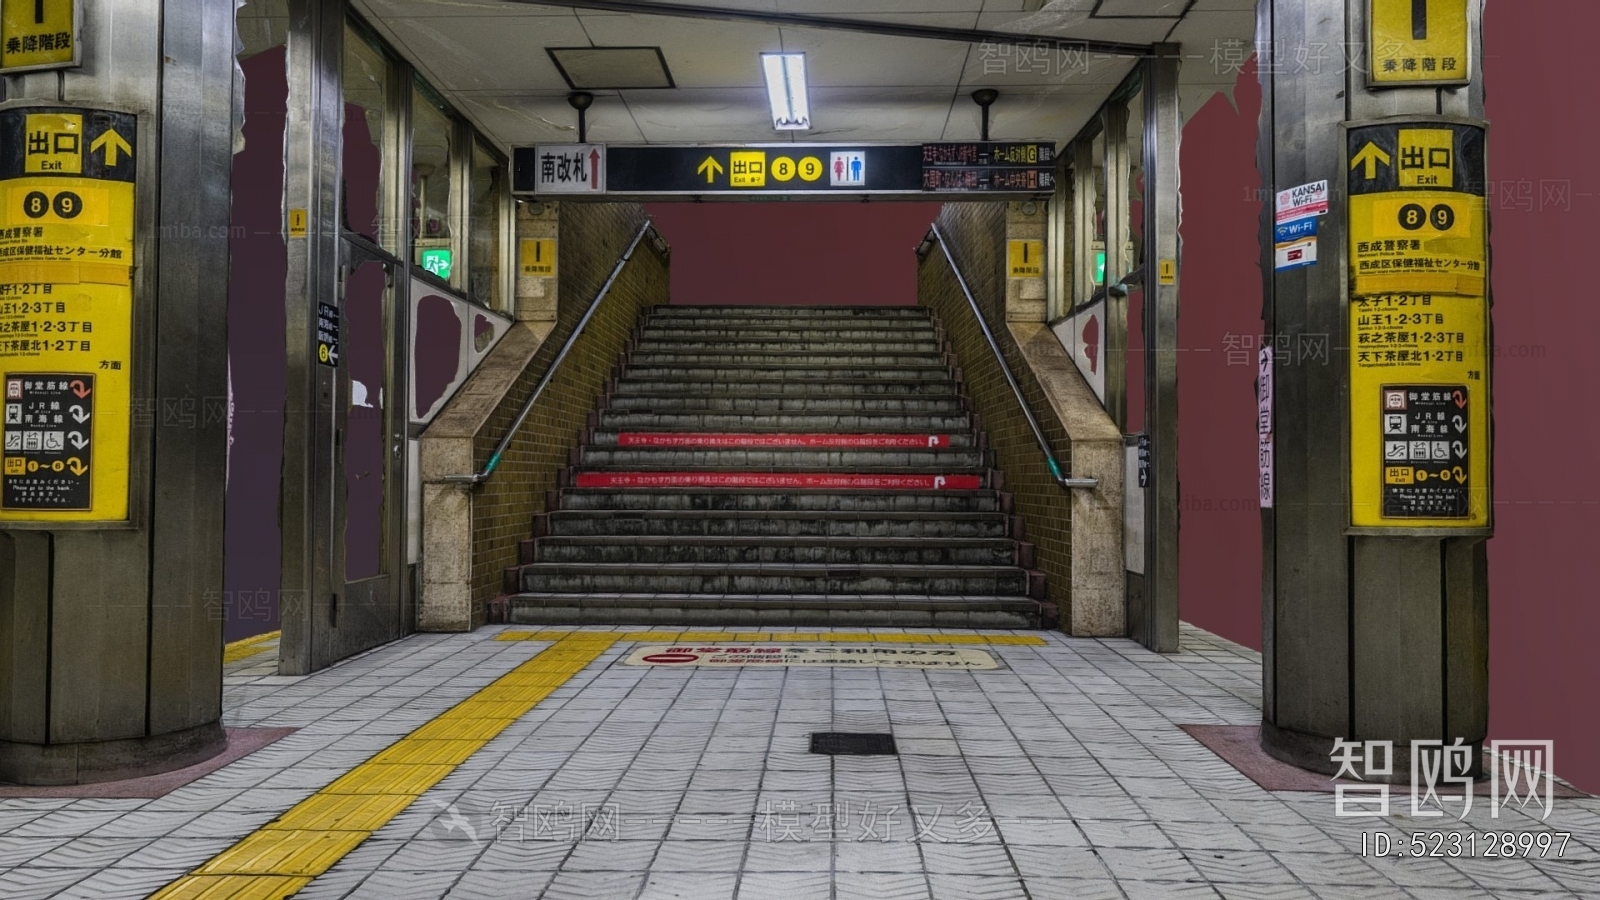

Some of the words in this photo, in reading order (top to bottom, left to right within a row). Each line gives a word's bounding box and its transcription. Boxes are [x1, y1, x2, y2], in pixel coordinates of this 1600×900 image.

[6, 32, 71, 54] 乗降階段
[1383, 57, 1457, 73] 乗降階段
[28, 131, 79, 155] 出口
[1401, 146, 1450, 170] 出口
[41, 161, 62, 171] Exit
[541, 153, 587, 183] 南改札
[733, 160, 762, 174] 出口
[1417, 175, 1437, 184] Exit
[1292, 182, 1325, 198] KANSAI
[1293, 195, 1312, 207] Wi-Fi
[1289, 222, 1312, 234] Wi-Fi
[1357, 240, 1420, 253] 西成警察署
[1359, 258, 1480, 271] 西成区保健福祉センター分館
[1358, 314, 1444, 326] 山王1・2・3丁目
[0, 340, 90, 352] 下茶屋北1・2丁目
[1358, 351, 1463, 362] 天下茶屋北1・2丁目
[99, 360, 122, 370] 方面
[1467, 370, 1480, 380] 方面
[24, 381, 69, 391] 御堂筋線
[1409, 392, 1452, 401] 御堂筋線
[25, 415, 64, 424] 南海線
[1411, 425, 1448, 433] 南海線
[7, 459, 22, 468] 出口
[1390, 469, 1409, 477] 出口
